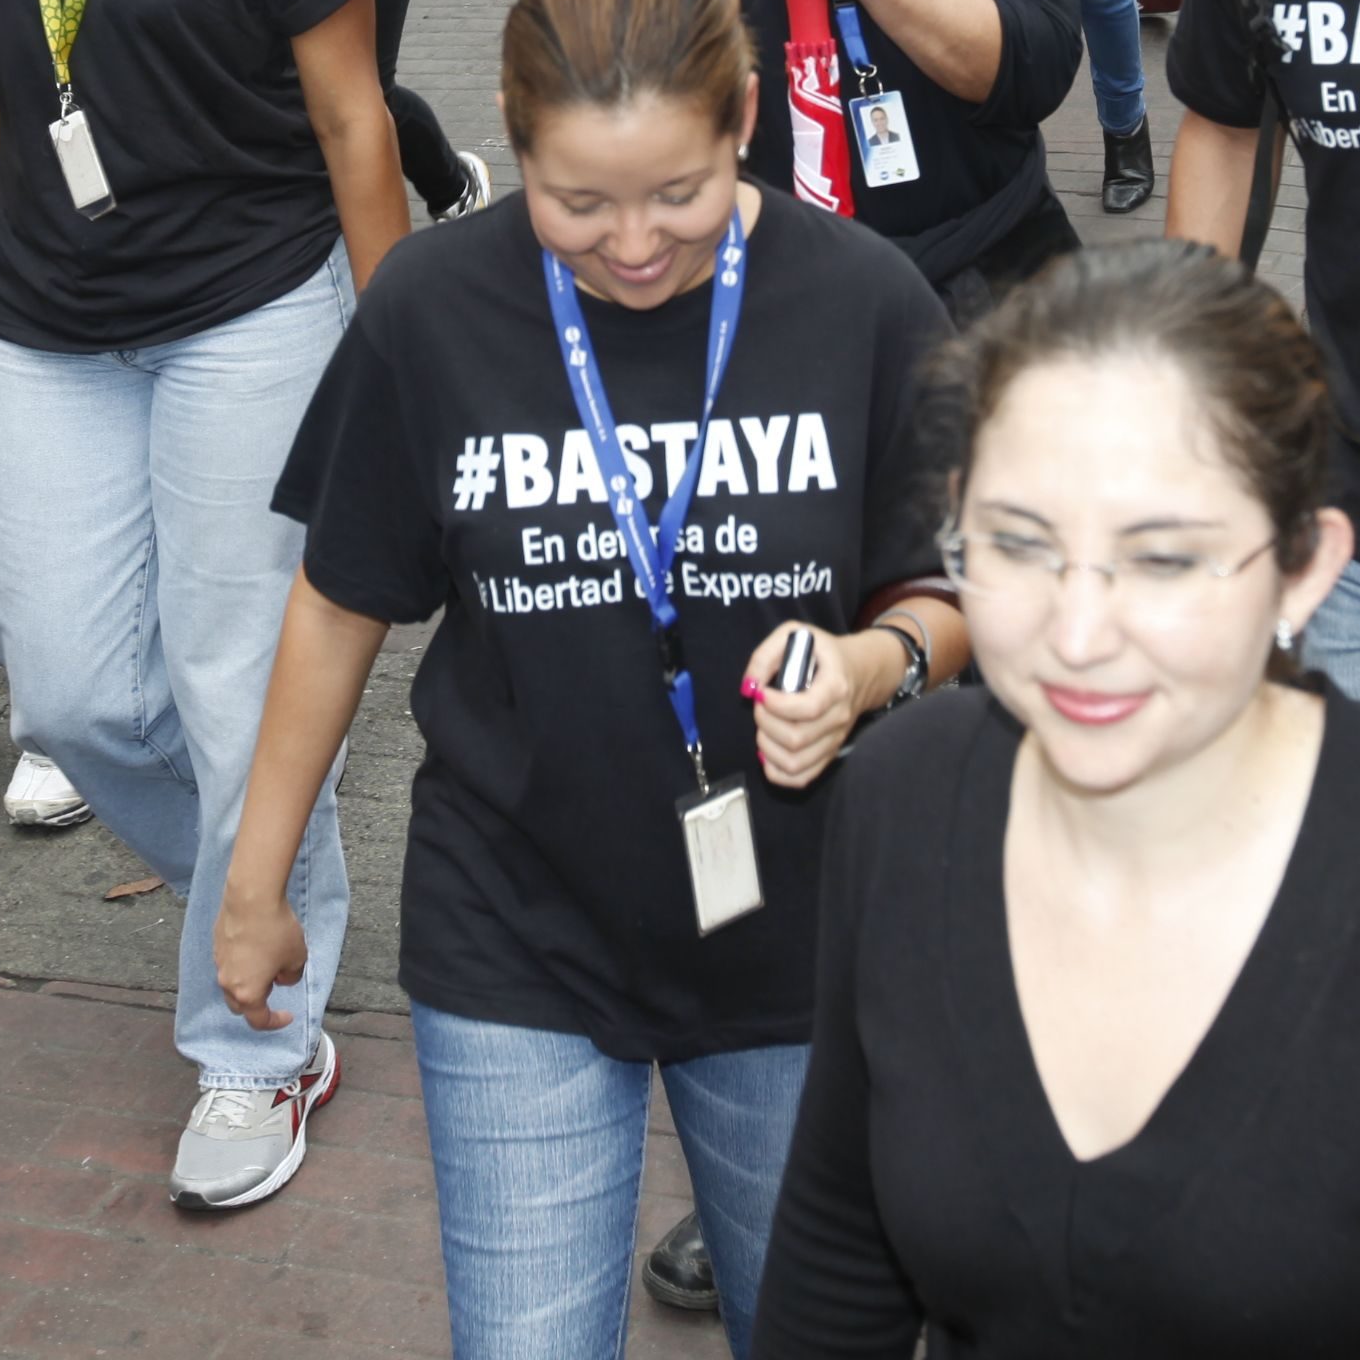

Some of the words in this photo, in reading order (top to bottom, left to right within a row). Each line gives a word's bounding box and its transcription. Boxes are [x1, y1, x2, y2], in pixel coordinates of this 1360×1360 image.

[1321, 81, 1355, 113] En
[453, 413, 837, 510] #BASTAYA
[522, 526, 565, 565] En
[715, 515, 758, 554] de
[489, 568, 623, 613] Libertad
[682, 561, 832, 606] Expresión
